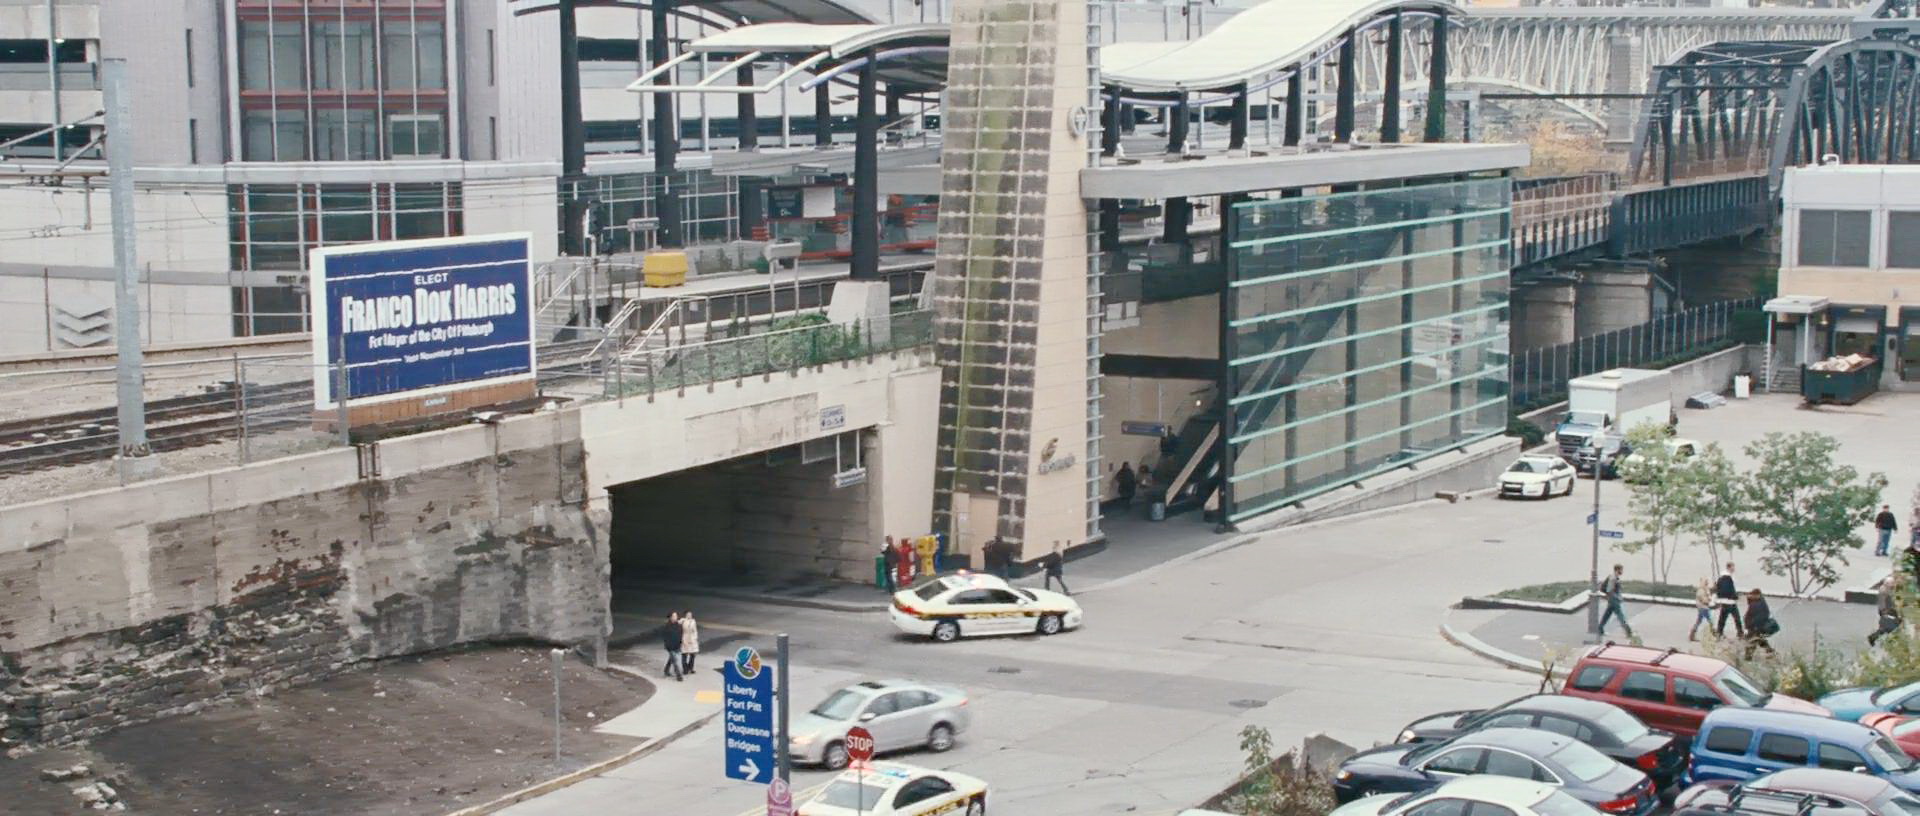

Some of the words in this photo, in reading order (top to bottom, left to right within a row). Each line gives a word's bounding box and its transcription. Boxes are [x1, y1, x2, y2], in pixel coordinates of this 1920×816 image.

[414, 273, 448, 286] ELECT
[342, 295, 413, 333] FRANCO
[415, 287, 452, 326] DOK
[454, 283, 516, 320] HARRIS
[368, 335, 383, 349] For
[383, 333, 408, 348] Mayor
[409, 330, 417, 344] of
[418, 329, 431, 343] the
[431, 327, 446, 342] City
[727, 684, 757, 699] Liberty
[727, 698, 745, 710] Fort
[746, 701, 762, 712] Pitt
[727, 711, 745, 722] Fort
[727, 722, 770, 737] Duquesne
[727, 738, 761, 752] Bridges
[847, 735, 873, 752] STOP
